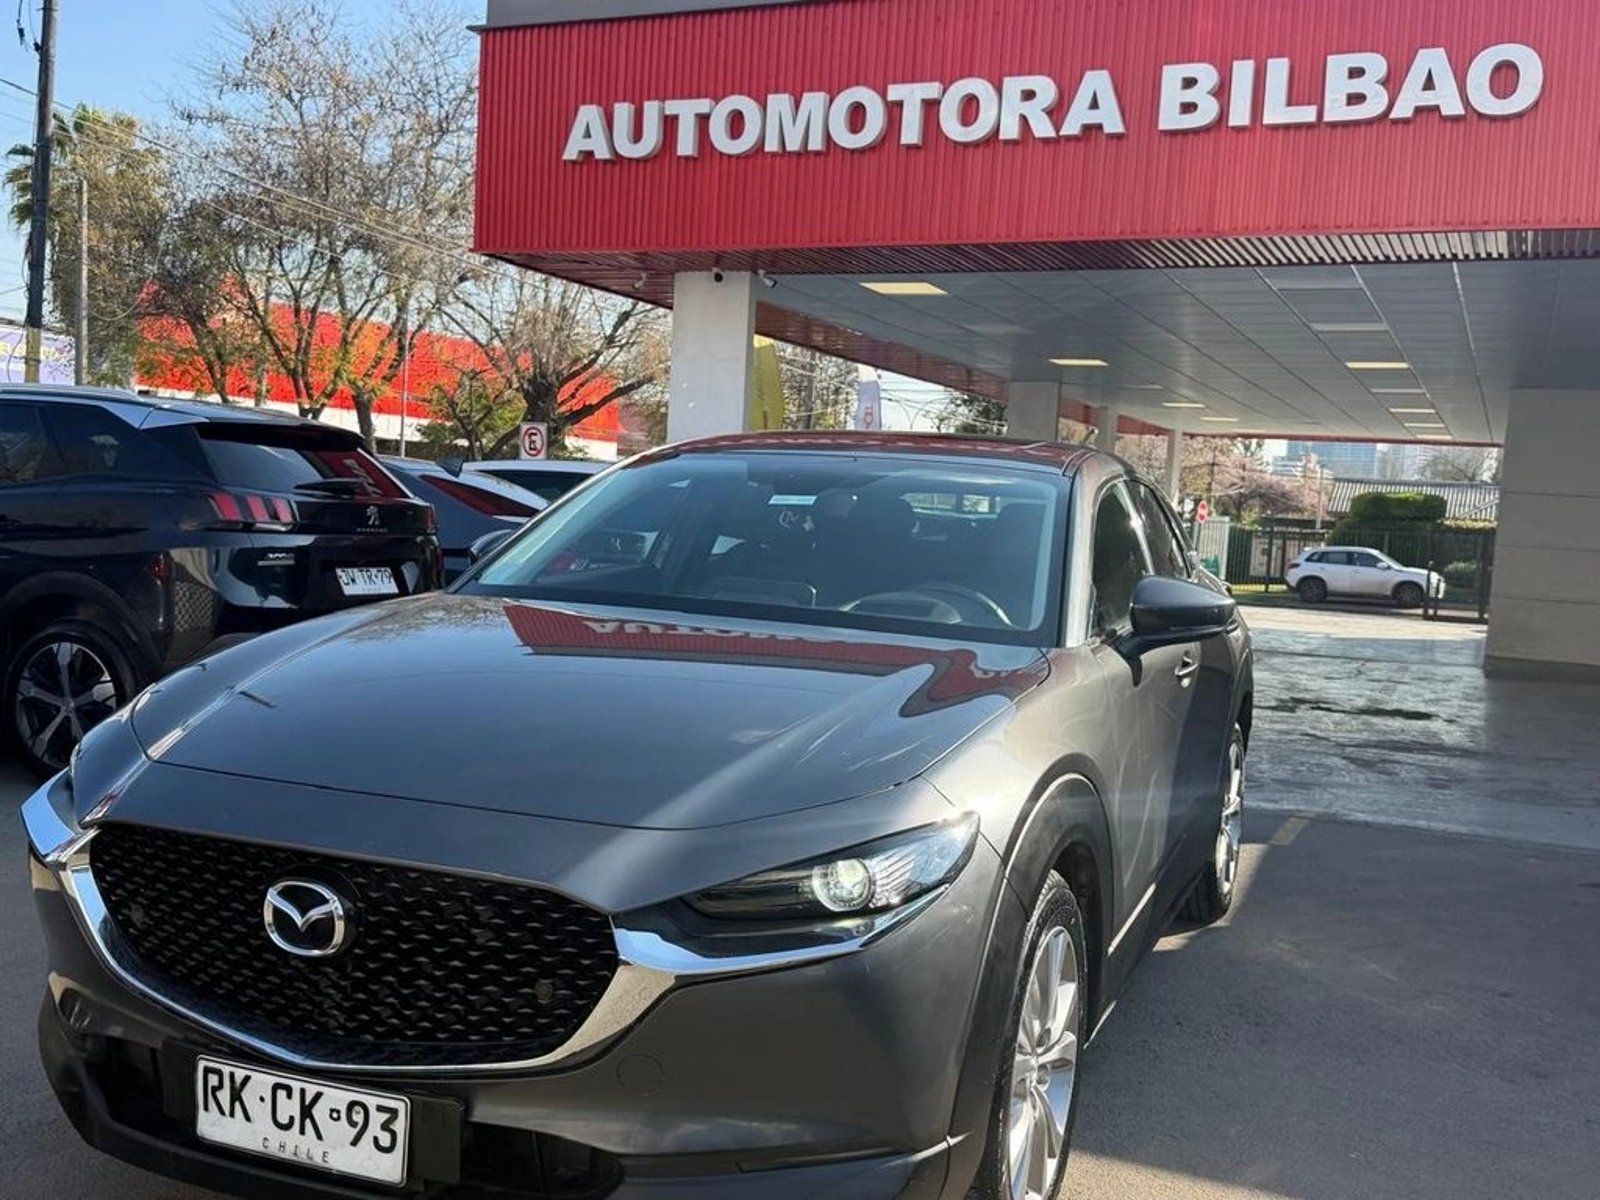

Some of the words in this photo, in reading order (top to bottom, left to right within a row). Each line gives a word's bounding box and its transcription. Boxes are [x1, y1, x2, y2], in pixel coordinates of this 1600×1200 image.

[562, 69, 1127, 163] AUTOMOTORA
[1157, 42, 1544, 132] BILBAO
[527, 431, 538, 451] E
[261, 1136, 331, 1164] CHILE
